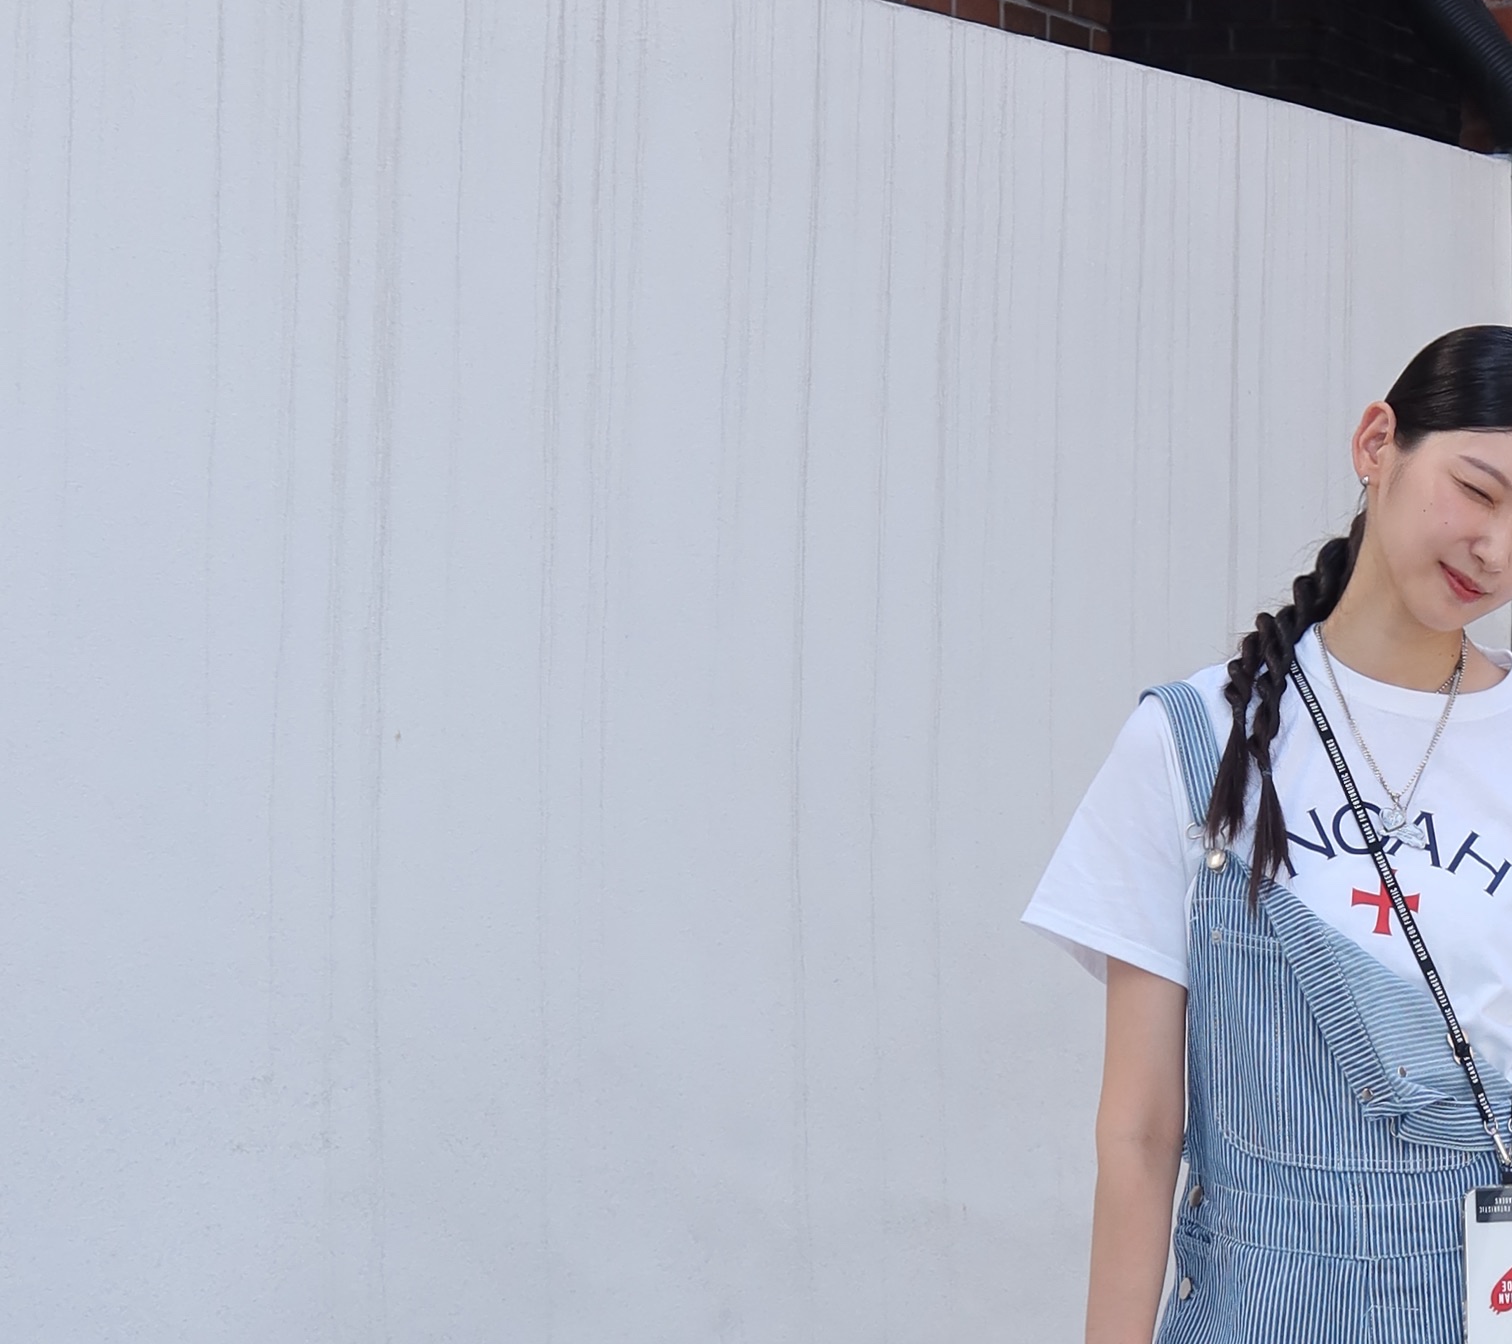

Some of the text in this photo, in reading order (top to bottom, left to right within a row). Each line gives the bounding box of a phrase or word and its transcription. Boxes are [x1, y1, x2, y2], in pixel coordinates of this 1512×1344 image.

[1309, 702, 1319, 713] FOR
[1314, 712, 1328, 731] GEARS
[1326, 738, 1375, 843] GEARS FOR FUTURISTIC TEENAGERS
[1284, 800, 1512, 897] NOAH
[1374, 851, 1427, 960] GEARS FOR FUTURISTIC TEENAGERS
[1426, 970, 1463, 1042] UTURISTIC TEENAGERS
[1464, 1061, 1478, 1083] GEARS
